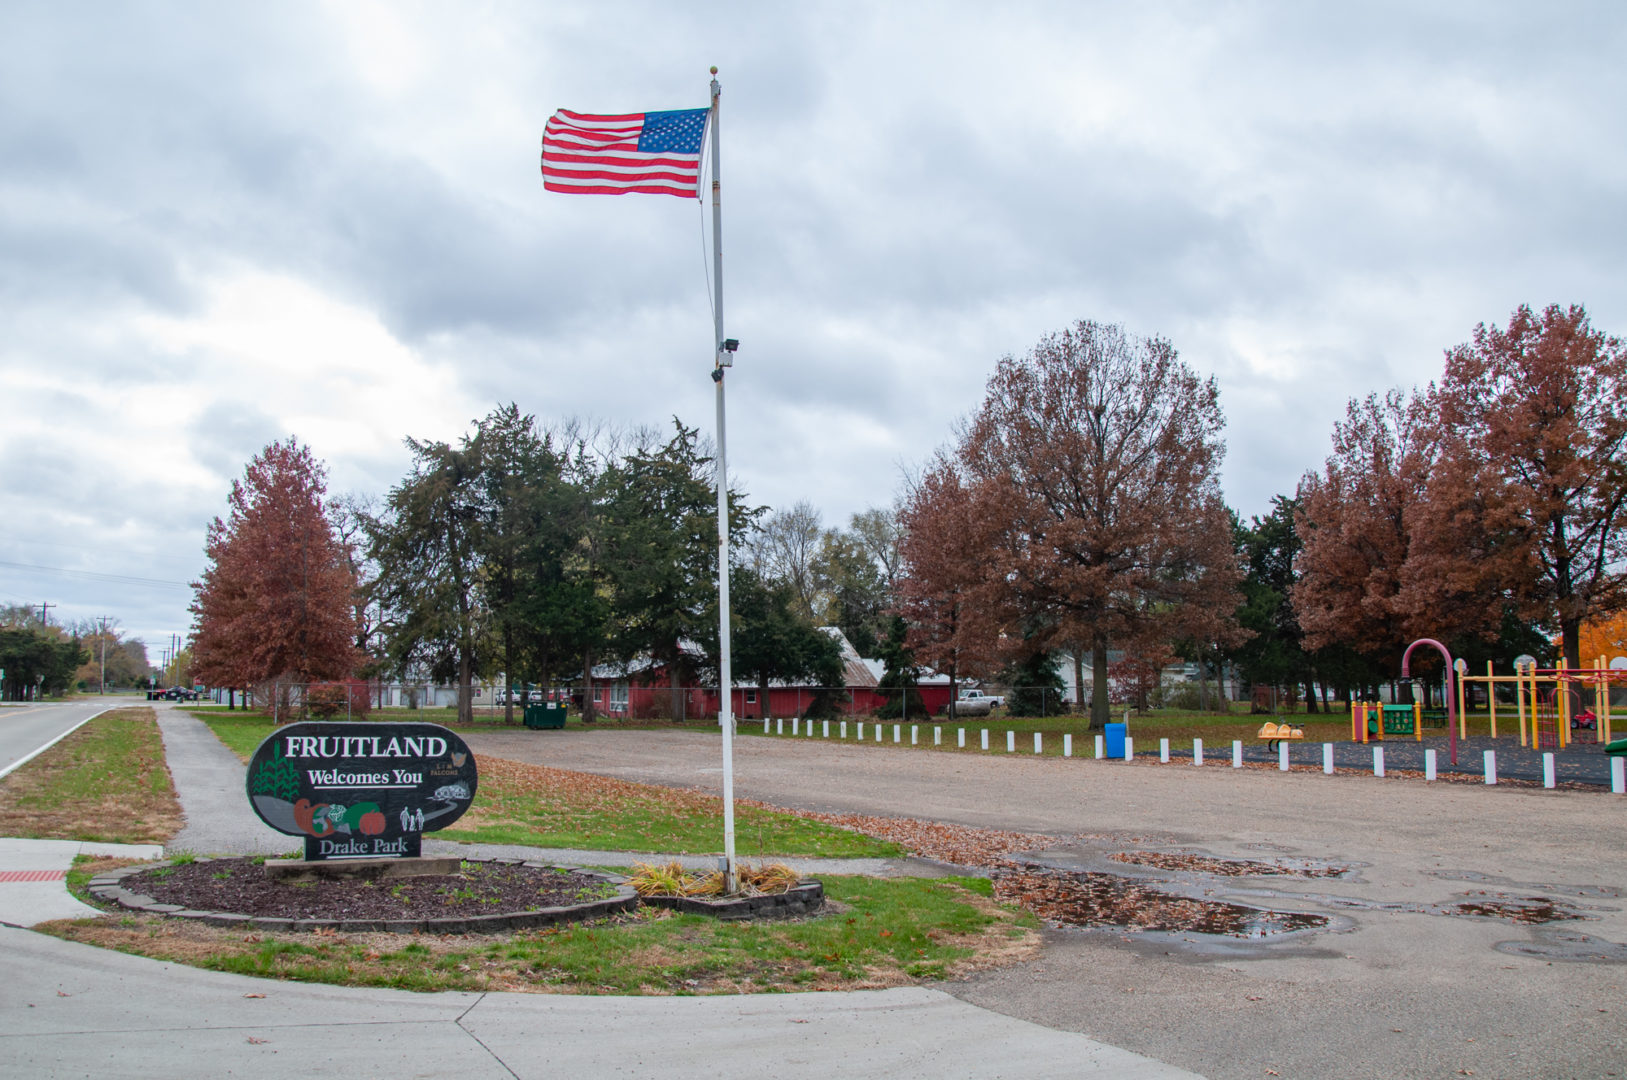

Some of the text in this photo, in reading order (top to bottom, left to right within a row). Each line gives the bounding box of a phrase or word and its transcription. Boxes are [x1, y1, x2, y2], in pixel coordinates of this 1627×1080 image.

[285, 736, 447, 758] FRUITLAND
[308, 769, 423, 785] Welcomes You
[320, 837, 408, 855] Drake Park
